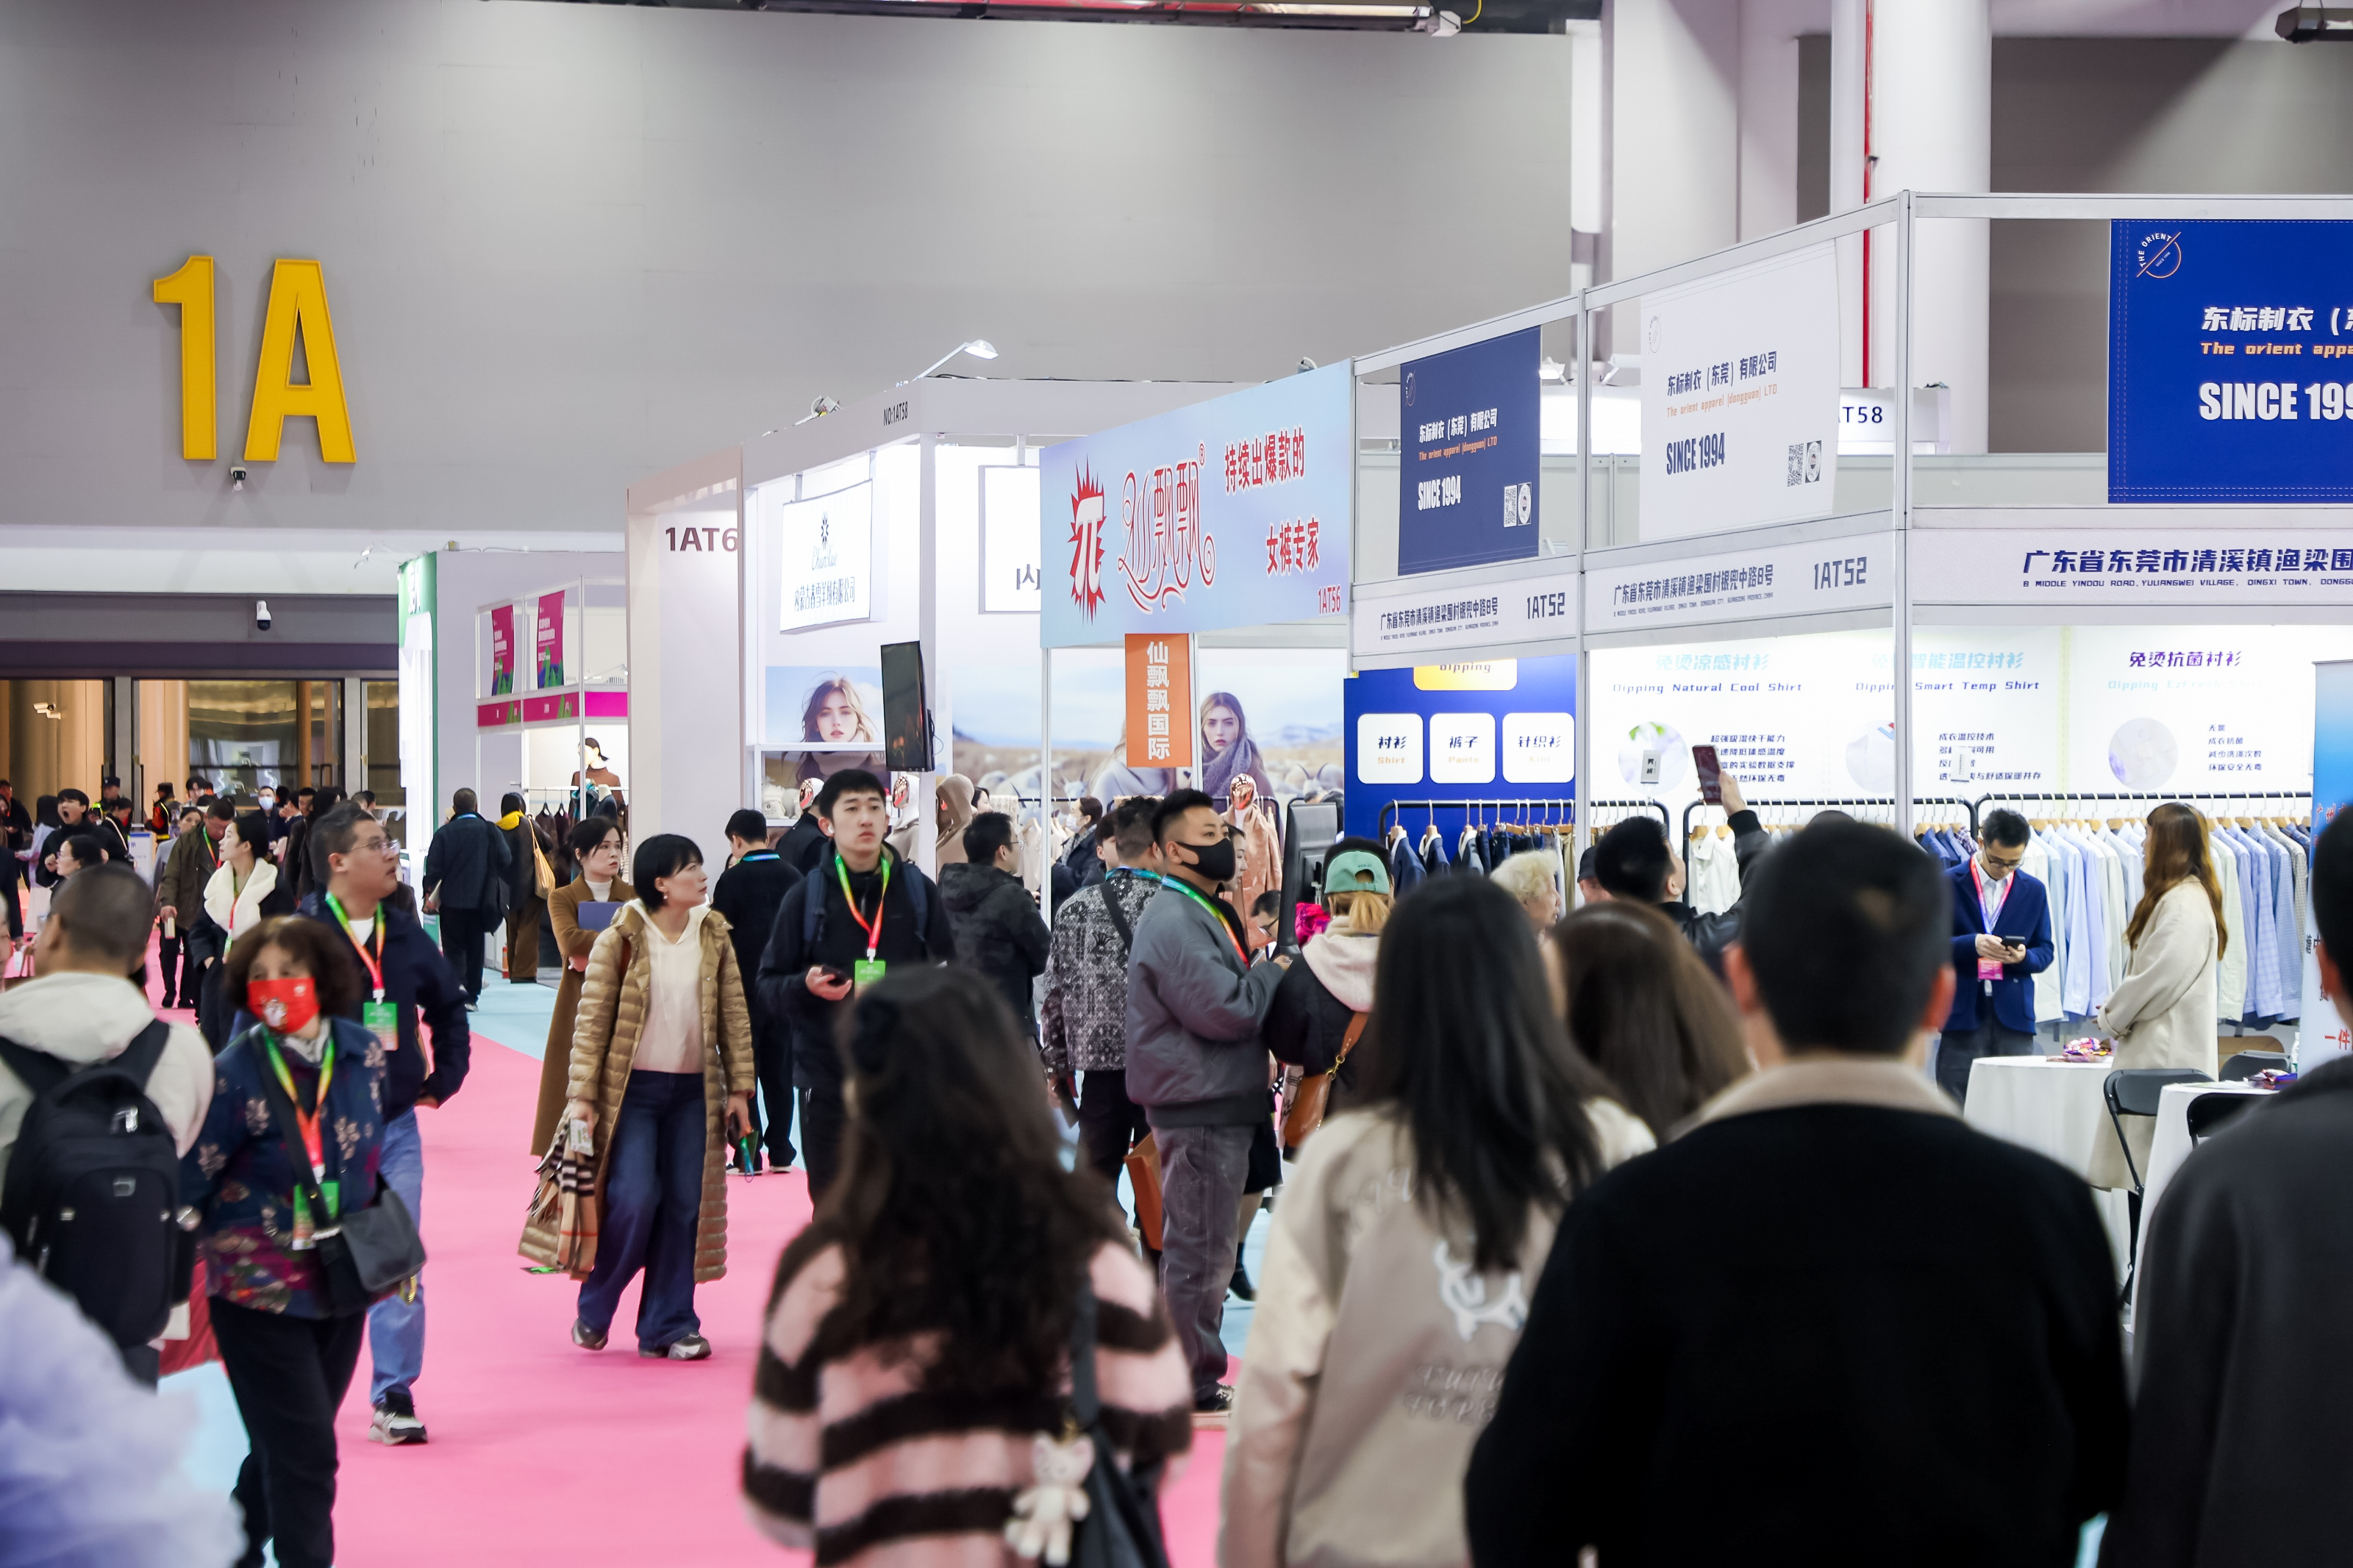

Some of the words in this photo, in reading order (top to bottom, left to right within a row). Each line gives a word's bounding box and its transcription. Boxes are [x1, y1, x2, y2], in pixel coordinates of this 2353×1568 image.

[2141, 233, 2172, 247] ORIENT
[2138, 250, 2146, 268] THE
[2201, 343, 2235, 355] The
[2246, 343, 2302, 355] orient
[154, 255, 357, 463] 1A
[1667, 351, 1777, 396] 东标制衣（东莞）有限公司
[1667, 407, 1677, 418] The
[1680, 402, 1699, 415] orient
[1701, 394, 1724, 412] apparel
[1727, 386, 1761, 408] (dongguan)
[1765, 384, 1777, 397] LTD
[2199, 382, 2298, 420] SINCE
[883, 401, 908, 426] NO:1AT58
[1838, 407, 1882, 423] T58
[1488, 436, 1498, 447] LTD
[1224, 426, 1304, 493] 持续出爆款的
[1666, 438, 1696, 476] SINCE
[1699, 432, 1725, 469] 1994
[1418, 479, 1440, 511] SINCE
[1442, 475, 1461, 506] 1994
[1266, 517, 1319, 575] 女裤专家
[1814, 556, 1868, 590] 1AT52
[1318, 586, 1340, 615] 1AT56
[1527, 592, 1565, 620] 1AT52
[1656, 654, 1770, 670] 免烫凉感衬衫
[1872, 652, 2025, 669] 免智能温控衬衫
[2129, 651, 2242, 667] 免烫抗菌衬衫
[1613, 684, 1664, 695] Dipping
[1672, 683, 1722, 692] Natural
[1731, 683, 1760, 692] Cool
[1768, 683, 1802, 691] Shirt
[1856, 682, 1894, 693] Dippi
[1915, 682, 1954, 690] Smart
[1962, 681, 1997, 692] Temp
[2004, 681, 2040, 690] Shirt
[2108, 680, 2159, 691] Dipping
[1146, 641, 1171, 760] 仙飘飘国际
[1378, 736, 1407, 749] 衬衫
[1449, 736, 1478, 748] 裤子
[1518, 735, 1561, 748] 针织衫
[1377, 756, 1406, 765] Shirt
[1449, 756, 1479, 764] Pants
[1721, 761, 1795, 769] 富的实验数据支撑
